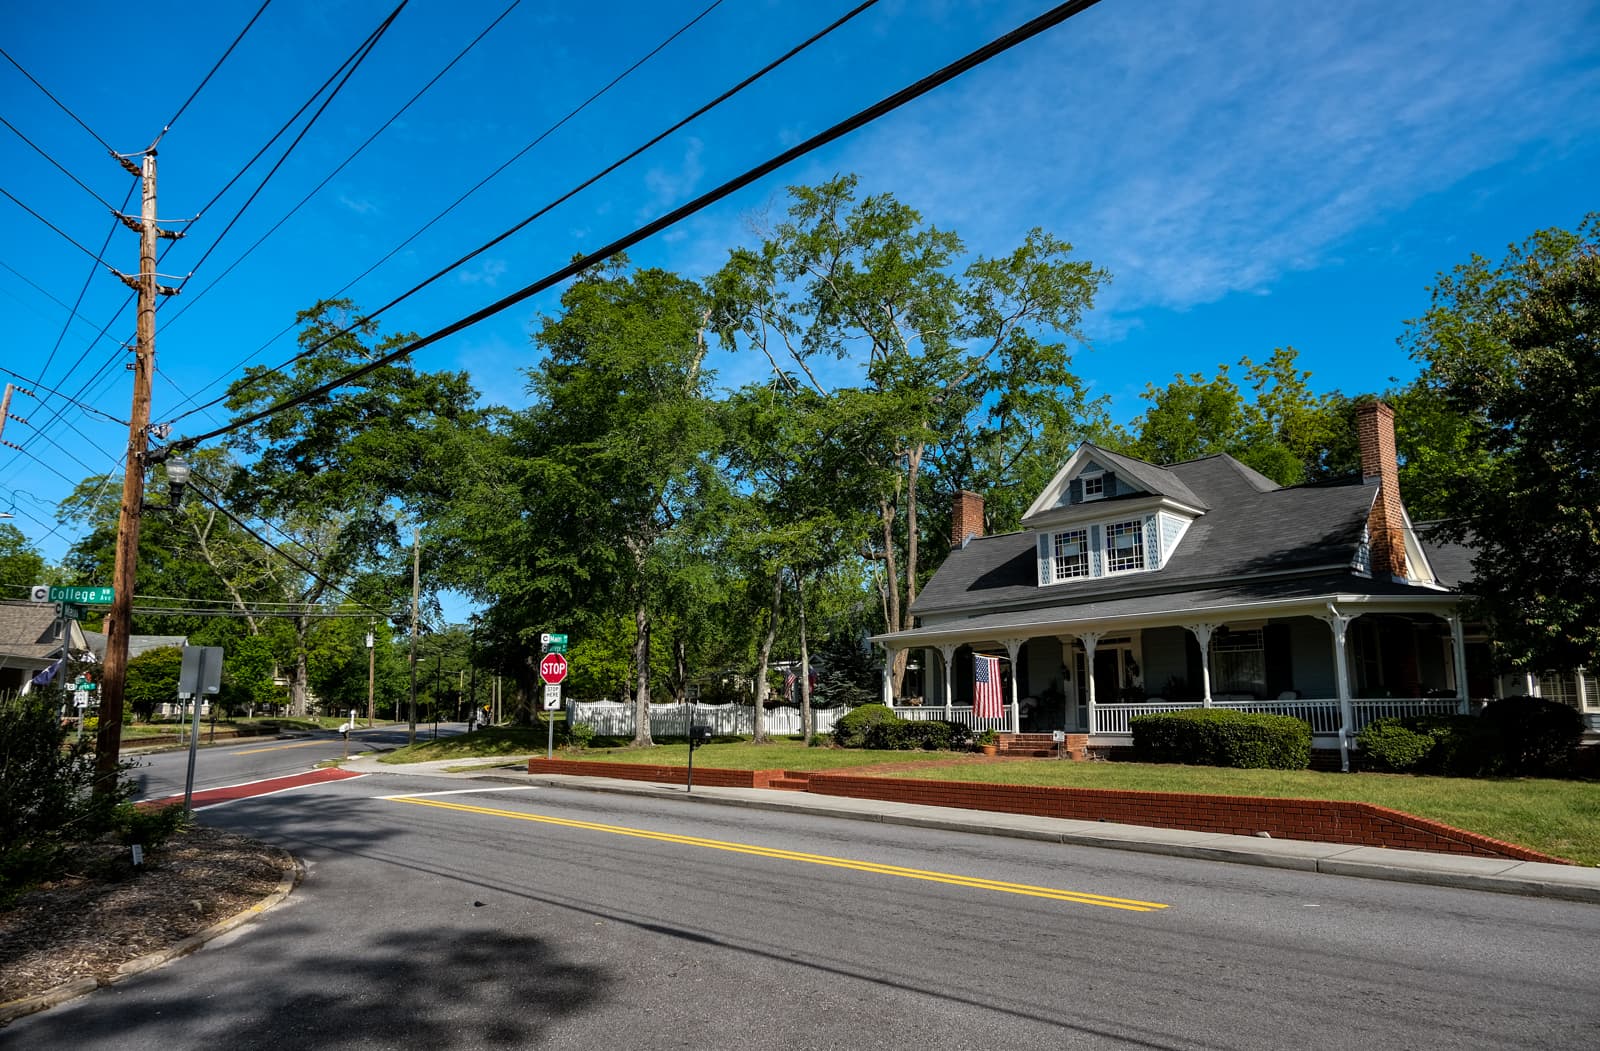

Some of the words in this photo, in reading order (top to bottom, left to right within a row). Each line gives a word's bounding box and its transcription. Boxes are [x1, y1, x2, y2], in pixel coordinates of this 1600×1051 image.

[35, 589, 47, 600] C
[51, 588, 96, 602] College
[542, 663, 565, 674] STOP
